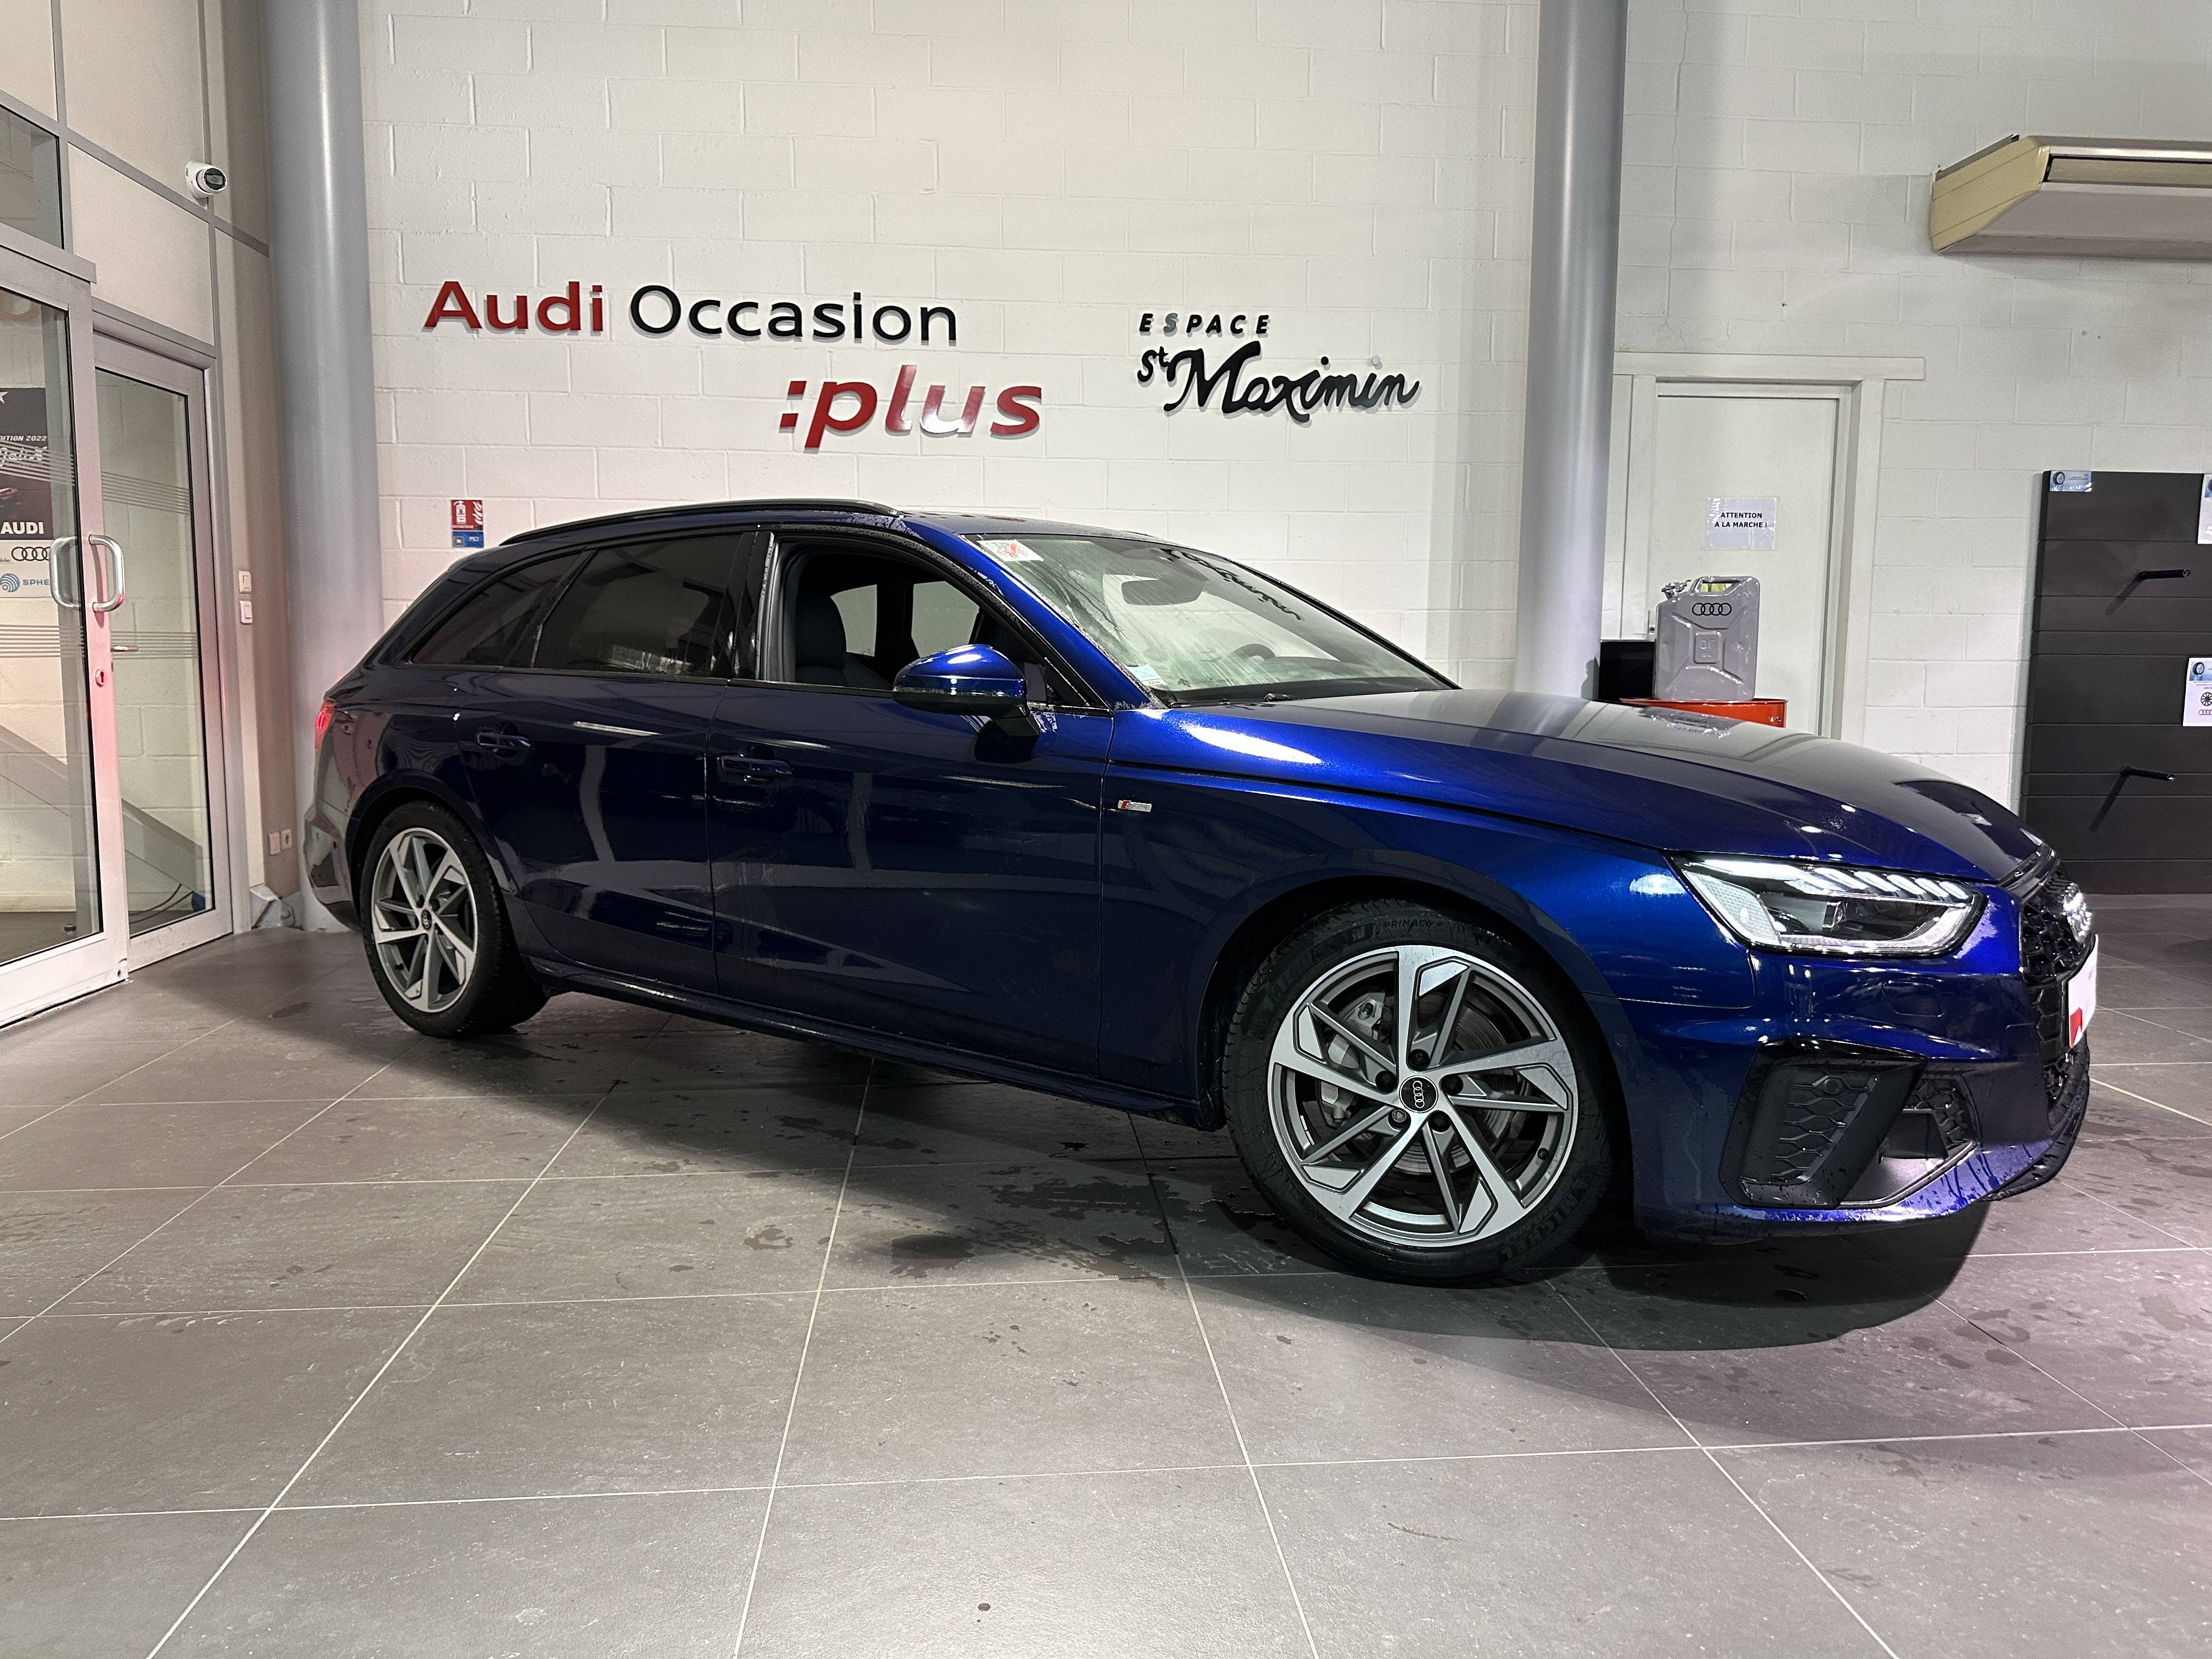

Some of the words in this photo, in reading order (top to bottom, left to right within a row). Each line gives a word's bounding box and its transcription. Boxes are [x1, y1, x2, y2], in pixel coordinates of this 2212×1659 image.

[424, 280, 604, 332] Audi
[629, 284, 958, 342] Occasion
[1139, 313, 1269, 335] ESPACE
[1137, 346, 1169, 382] St
[1164, 341, 1420, 423] Maximin
[1, 521, 44, 535] AUDI
[1384, 918, 1436, 929] PRIMACY
